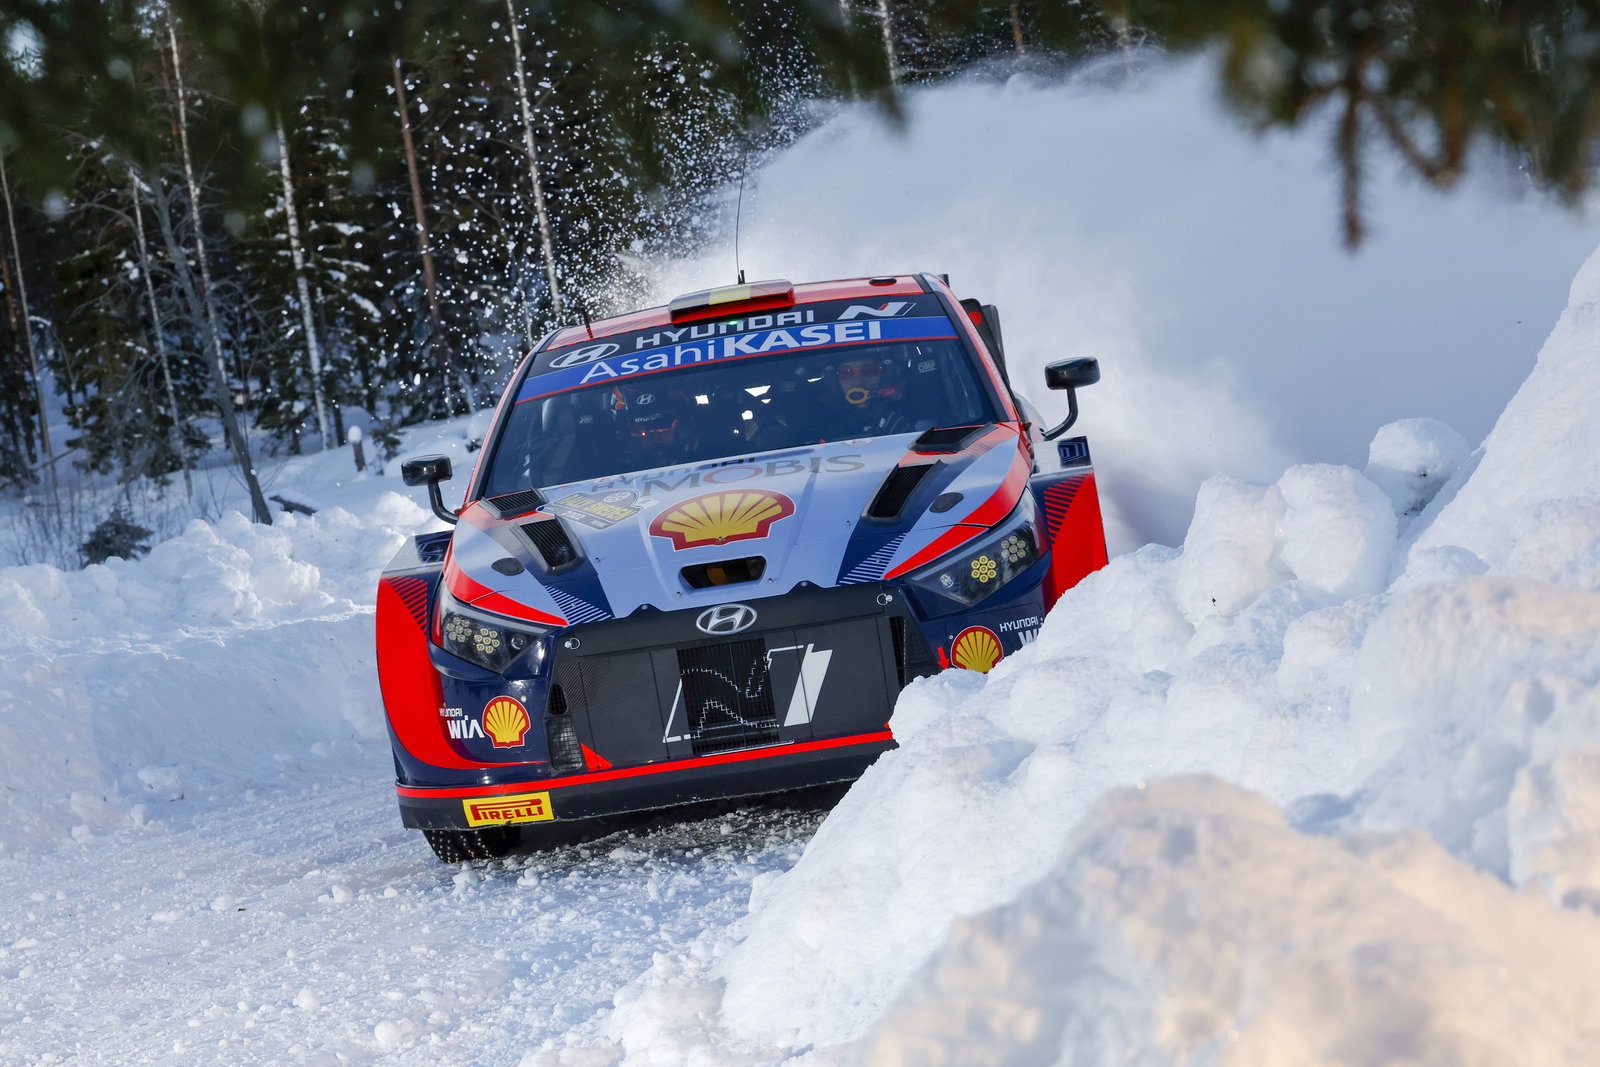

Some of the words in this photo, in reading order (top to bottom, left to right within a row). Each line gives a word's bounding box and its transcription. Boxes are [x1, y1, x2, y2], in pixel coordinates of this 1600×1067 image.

[636, 310, 814, 349] HYUNDAI
[643, 454, 866, 498] MOBIS
[1000, 616, 1039, 632] HYUNDAI
[470, 798, 544, 821] PIRELLI
